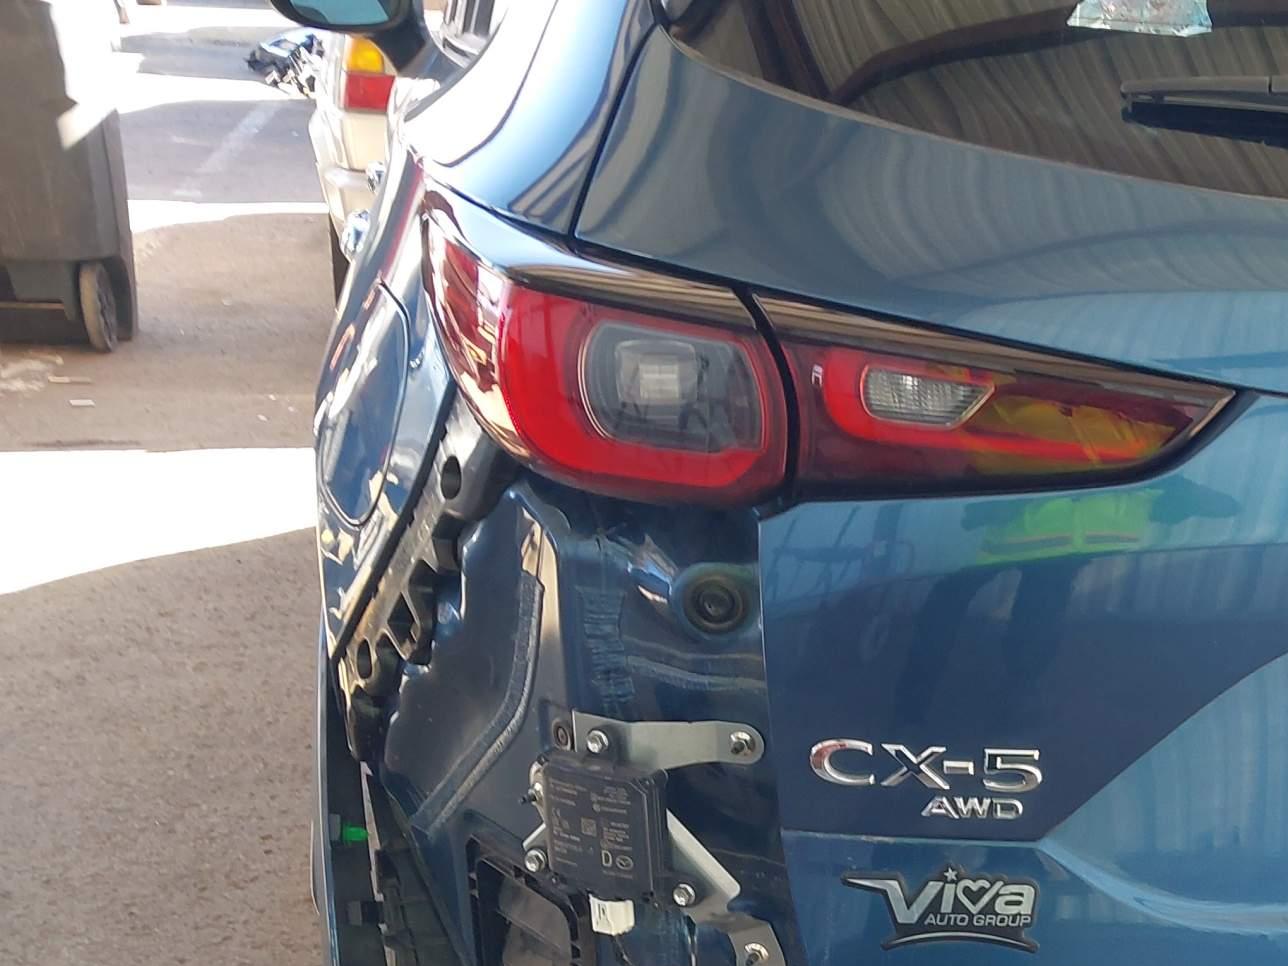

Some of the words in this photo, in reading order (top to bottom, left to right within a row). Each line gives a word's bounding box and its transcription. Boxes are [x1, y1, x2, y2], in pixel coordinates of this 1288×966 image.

[809, 738, 1043, 793] CX-5
[921, 796, 1024, 820] AWD
[924, 913, 969, 927] AUTO
[972, 913, 1032, 928] GROUP
